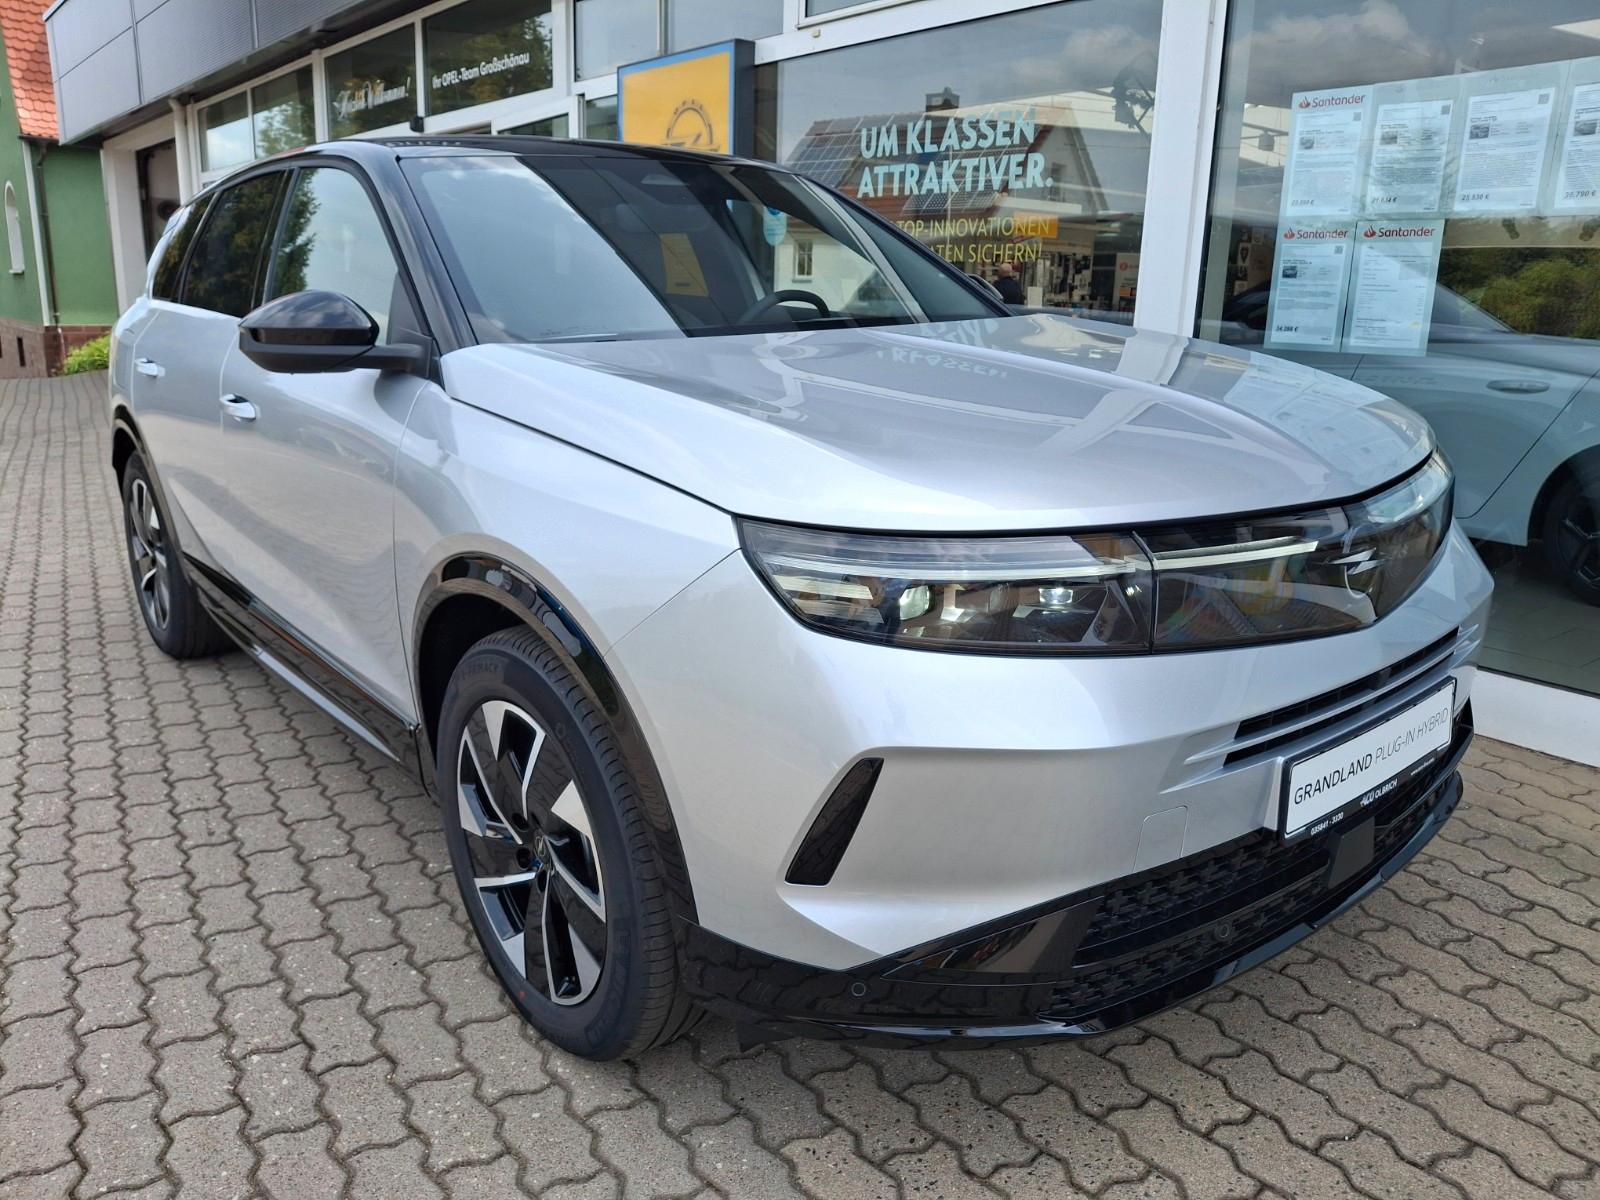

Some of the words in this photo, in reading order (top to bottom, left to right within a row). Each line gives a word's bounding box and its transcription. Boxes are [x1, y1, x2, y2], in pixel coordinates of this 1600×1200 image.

[432, 76, 442, 89] Ihr
[442, 66, 480, 87] OPEL-Team
[480, 52, 530, 76] Großschönau
[1312, 94, 1366, 108] Santander
[860, 124, 898, 159] UM
[906, 107, 1037, 155] KLASSEN
[856, 153, 1054, 198] ATTRAKTIVER.
[896, 216, 1049, 238] TOP-INNOVATIONEN
[1297, 228, 1349, 240] Santander
[1378, 226, 1435, 238] Santander
[968, 242, 1042, 263] SICHERN!
[1294, 753, 1373, 805] GRANDLAND
[1374, 727, 1416, 763] PLUG-IN
[1417, 707, 1449, 739] HYBRID
